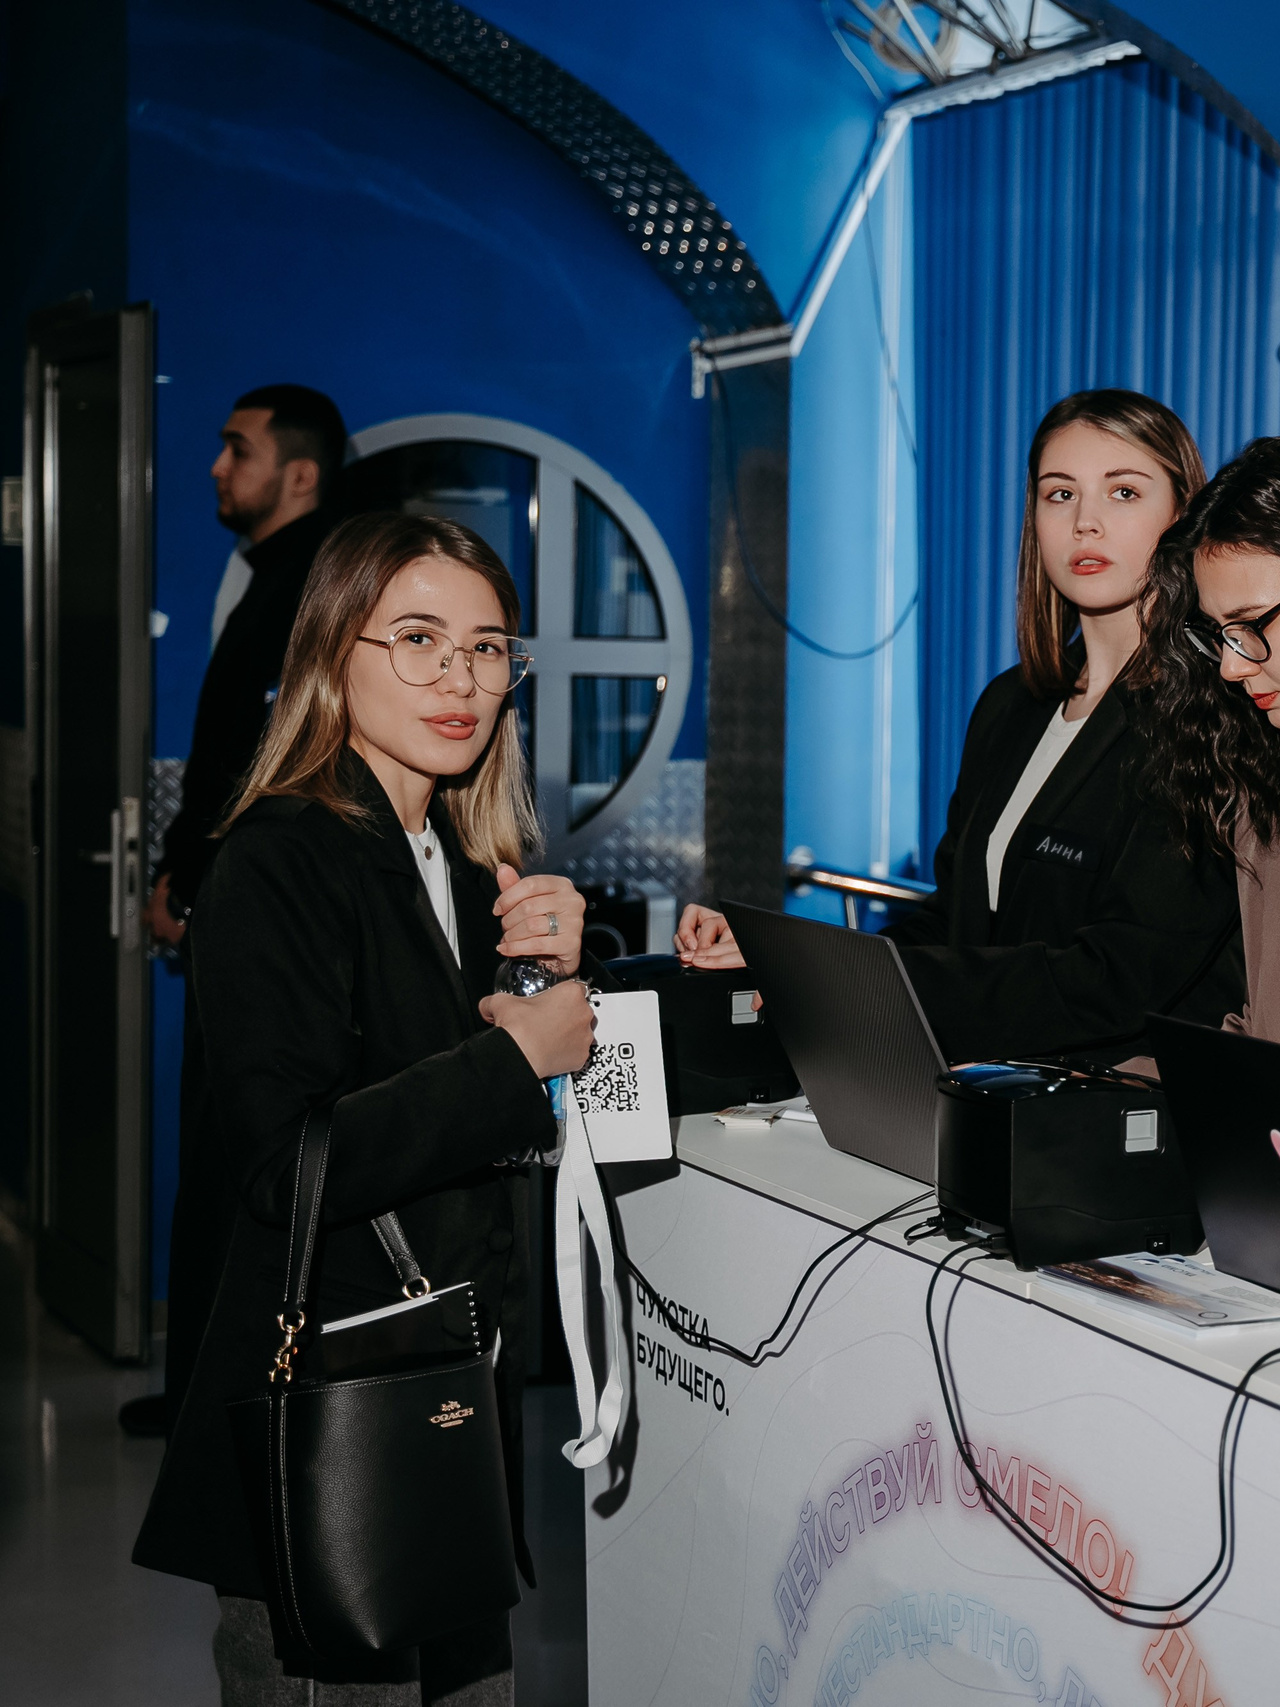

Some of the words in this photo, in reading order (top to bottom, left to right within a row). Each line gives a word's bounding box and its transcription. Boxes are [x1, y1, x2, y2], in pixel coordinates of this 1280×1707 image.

[429, 1407, 474, 1424] COACH
[637, 1332, 730, 1416] БУДУЩЕГО.
[774, 1422, 942, 1659] ДЕЙСТВУЙ
[954, 1442, 1135, 1615] СМЕЛО!
